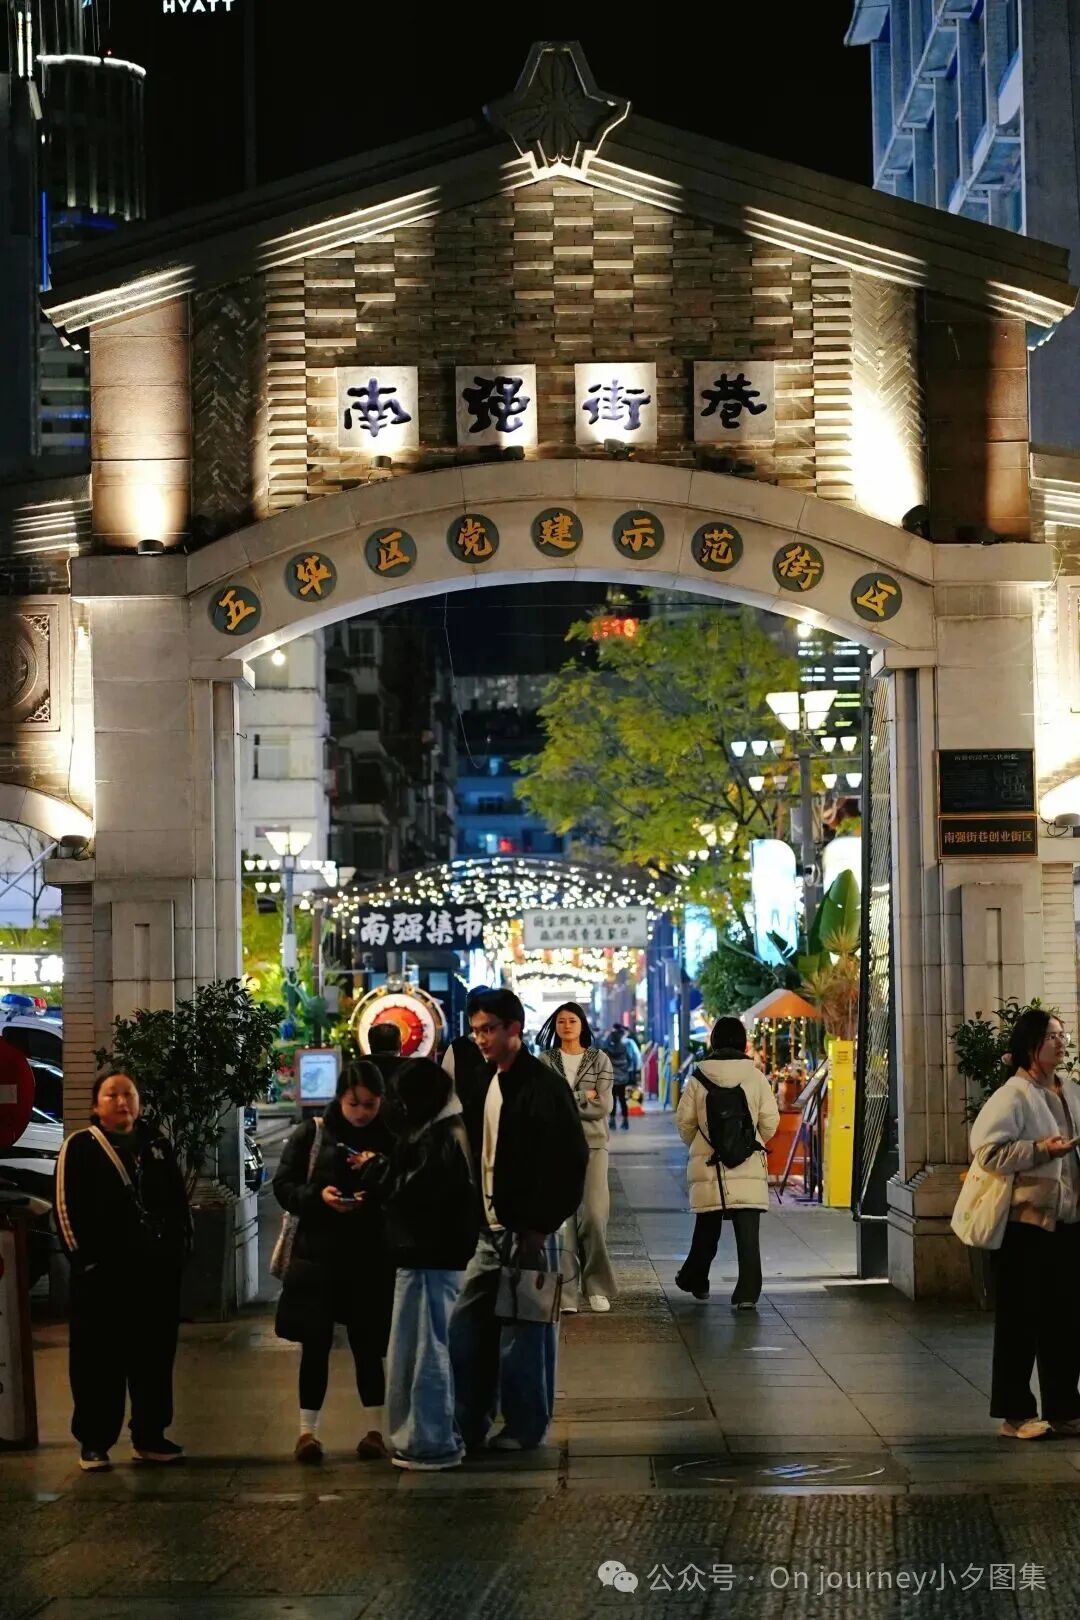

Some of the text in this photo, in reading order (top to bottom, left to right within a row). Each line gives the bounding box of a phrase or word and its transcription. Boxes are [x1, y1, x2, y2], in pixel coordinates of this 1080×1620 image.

[162, 0, 235, 14] HYATT
[343, 373, 767, 438] 南强街巷
[217, 512, 898, 631] 五华区党建示范街区
[360, 908, 484, 946] 南强集市
